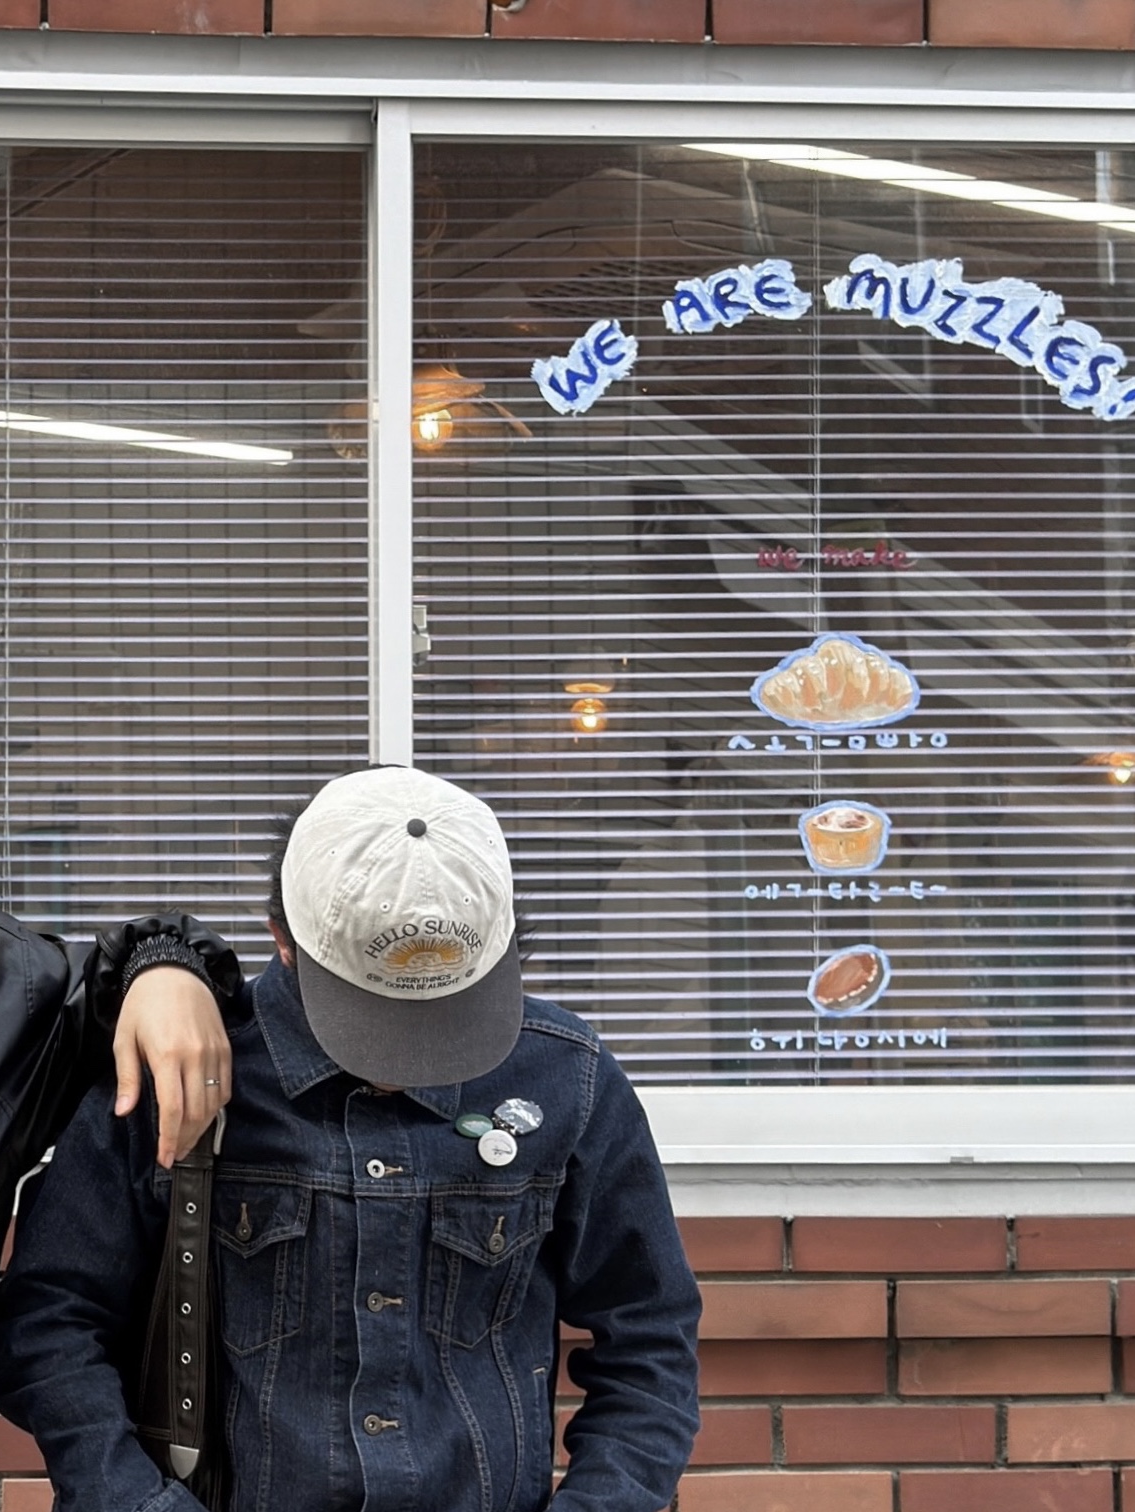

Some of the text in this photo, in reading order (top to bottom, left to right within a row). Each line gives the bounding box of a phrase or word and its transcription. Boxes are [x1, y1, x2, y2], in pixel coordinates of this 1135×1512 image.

[547, 325, 626, 403] WE
[672, 273, 793, 331] ARE
[822, 539, 919, 569] make
[364, 919, 483, 960] HELLO SUNRISE
[385, 976, 460, 991] GONNA BE ALRIGHT
